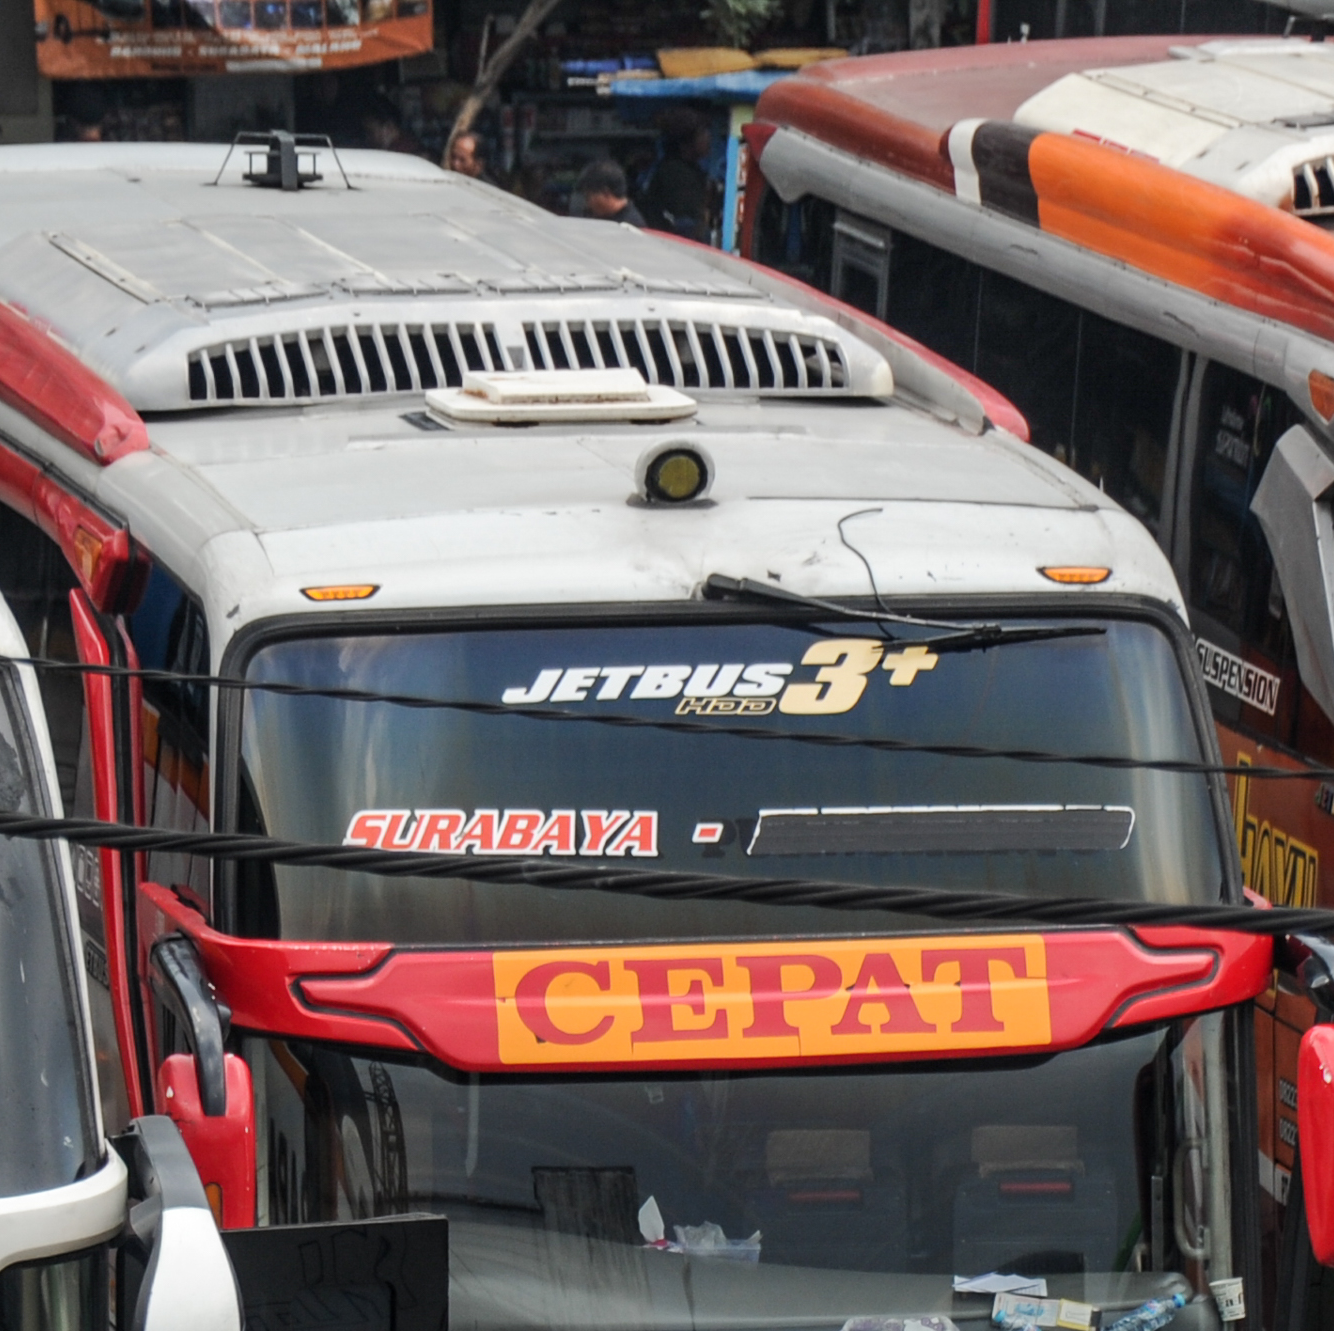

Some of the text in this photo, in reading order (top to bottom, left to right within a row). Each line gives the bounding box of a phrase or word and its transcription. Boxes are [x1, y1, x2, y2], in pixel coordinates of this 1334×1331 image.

[502, 663, 794, 705] JETBUS
[675, 697, 778, 716] HDD
[341, 807, 661, 858] SURABAYA
[514, 947, 1028, 1046] CEPAT
